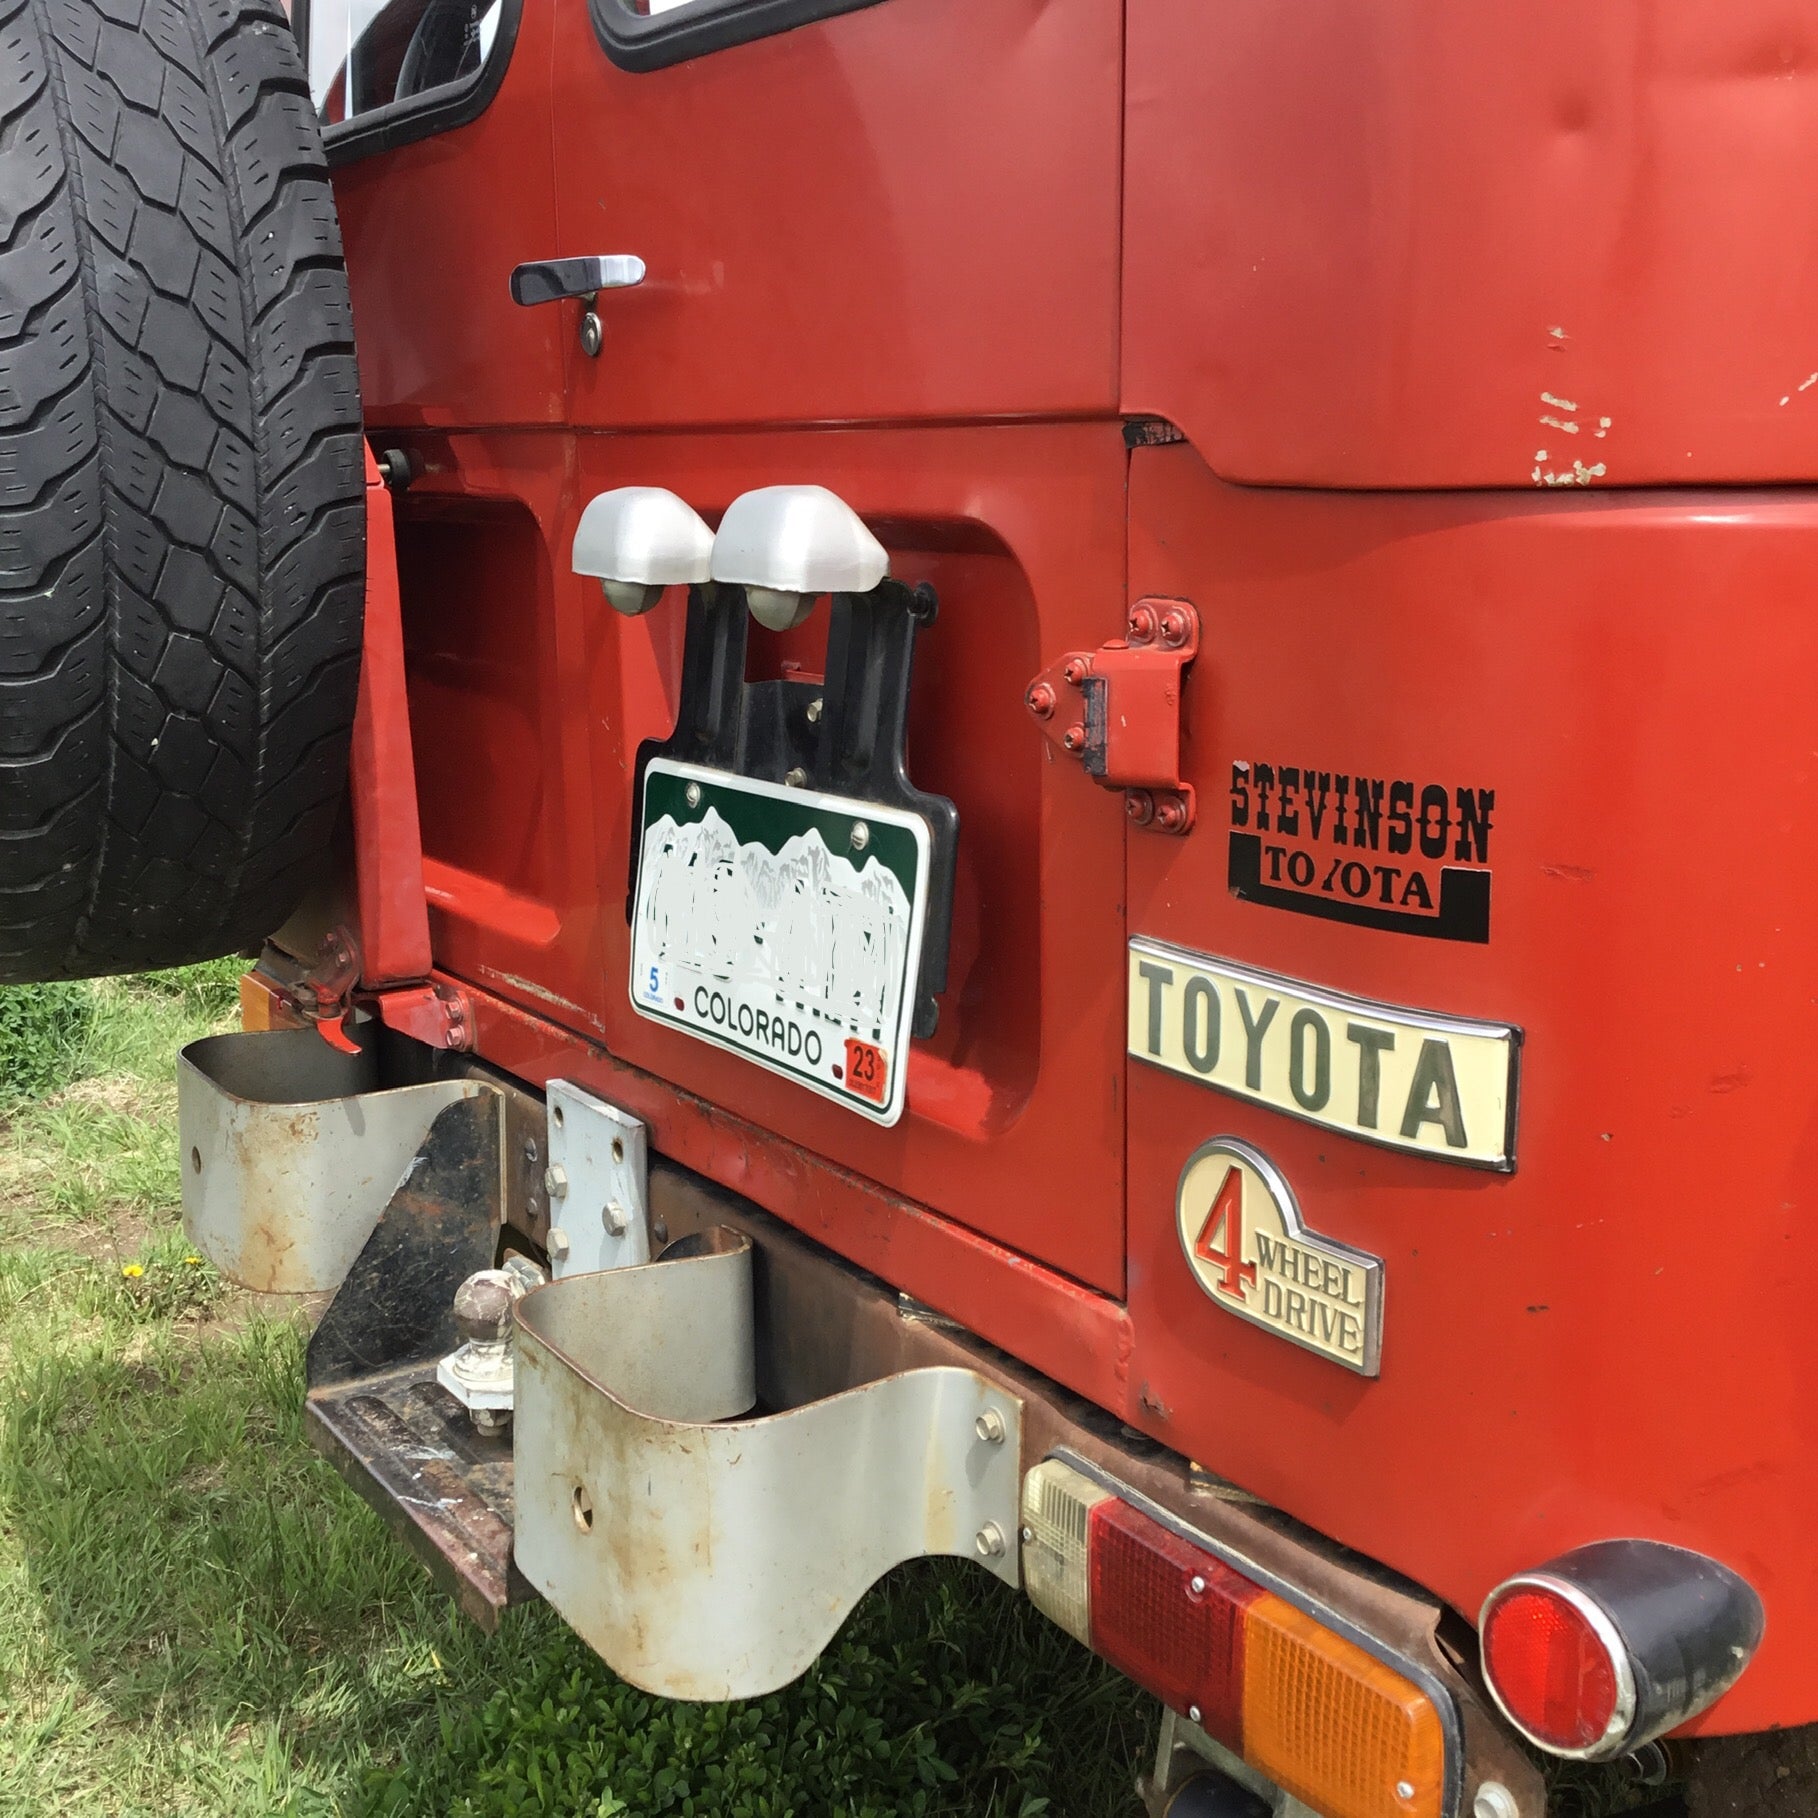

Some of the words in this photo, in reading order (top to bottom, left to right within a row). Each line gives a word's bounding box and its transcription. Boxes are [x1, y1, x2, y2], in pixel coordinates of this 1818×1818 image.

[1229, 760, 1495, 863] STEVINSON
[649, 966, 659, 992] 5
[694, 986, 822, 1065] COLORADO
[853, 1045, 875, 1081] 23
[1139, 960, 1468, 1148] TOYOTA
[1195, 1165, 1257, 1301] 4
[1255, 1232, 1361, 1307] WHEEL
[1263, 1279, 1362, 1354] DRIVE
